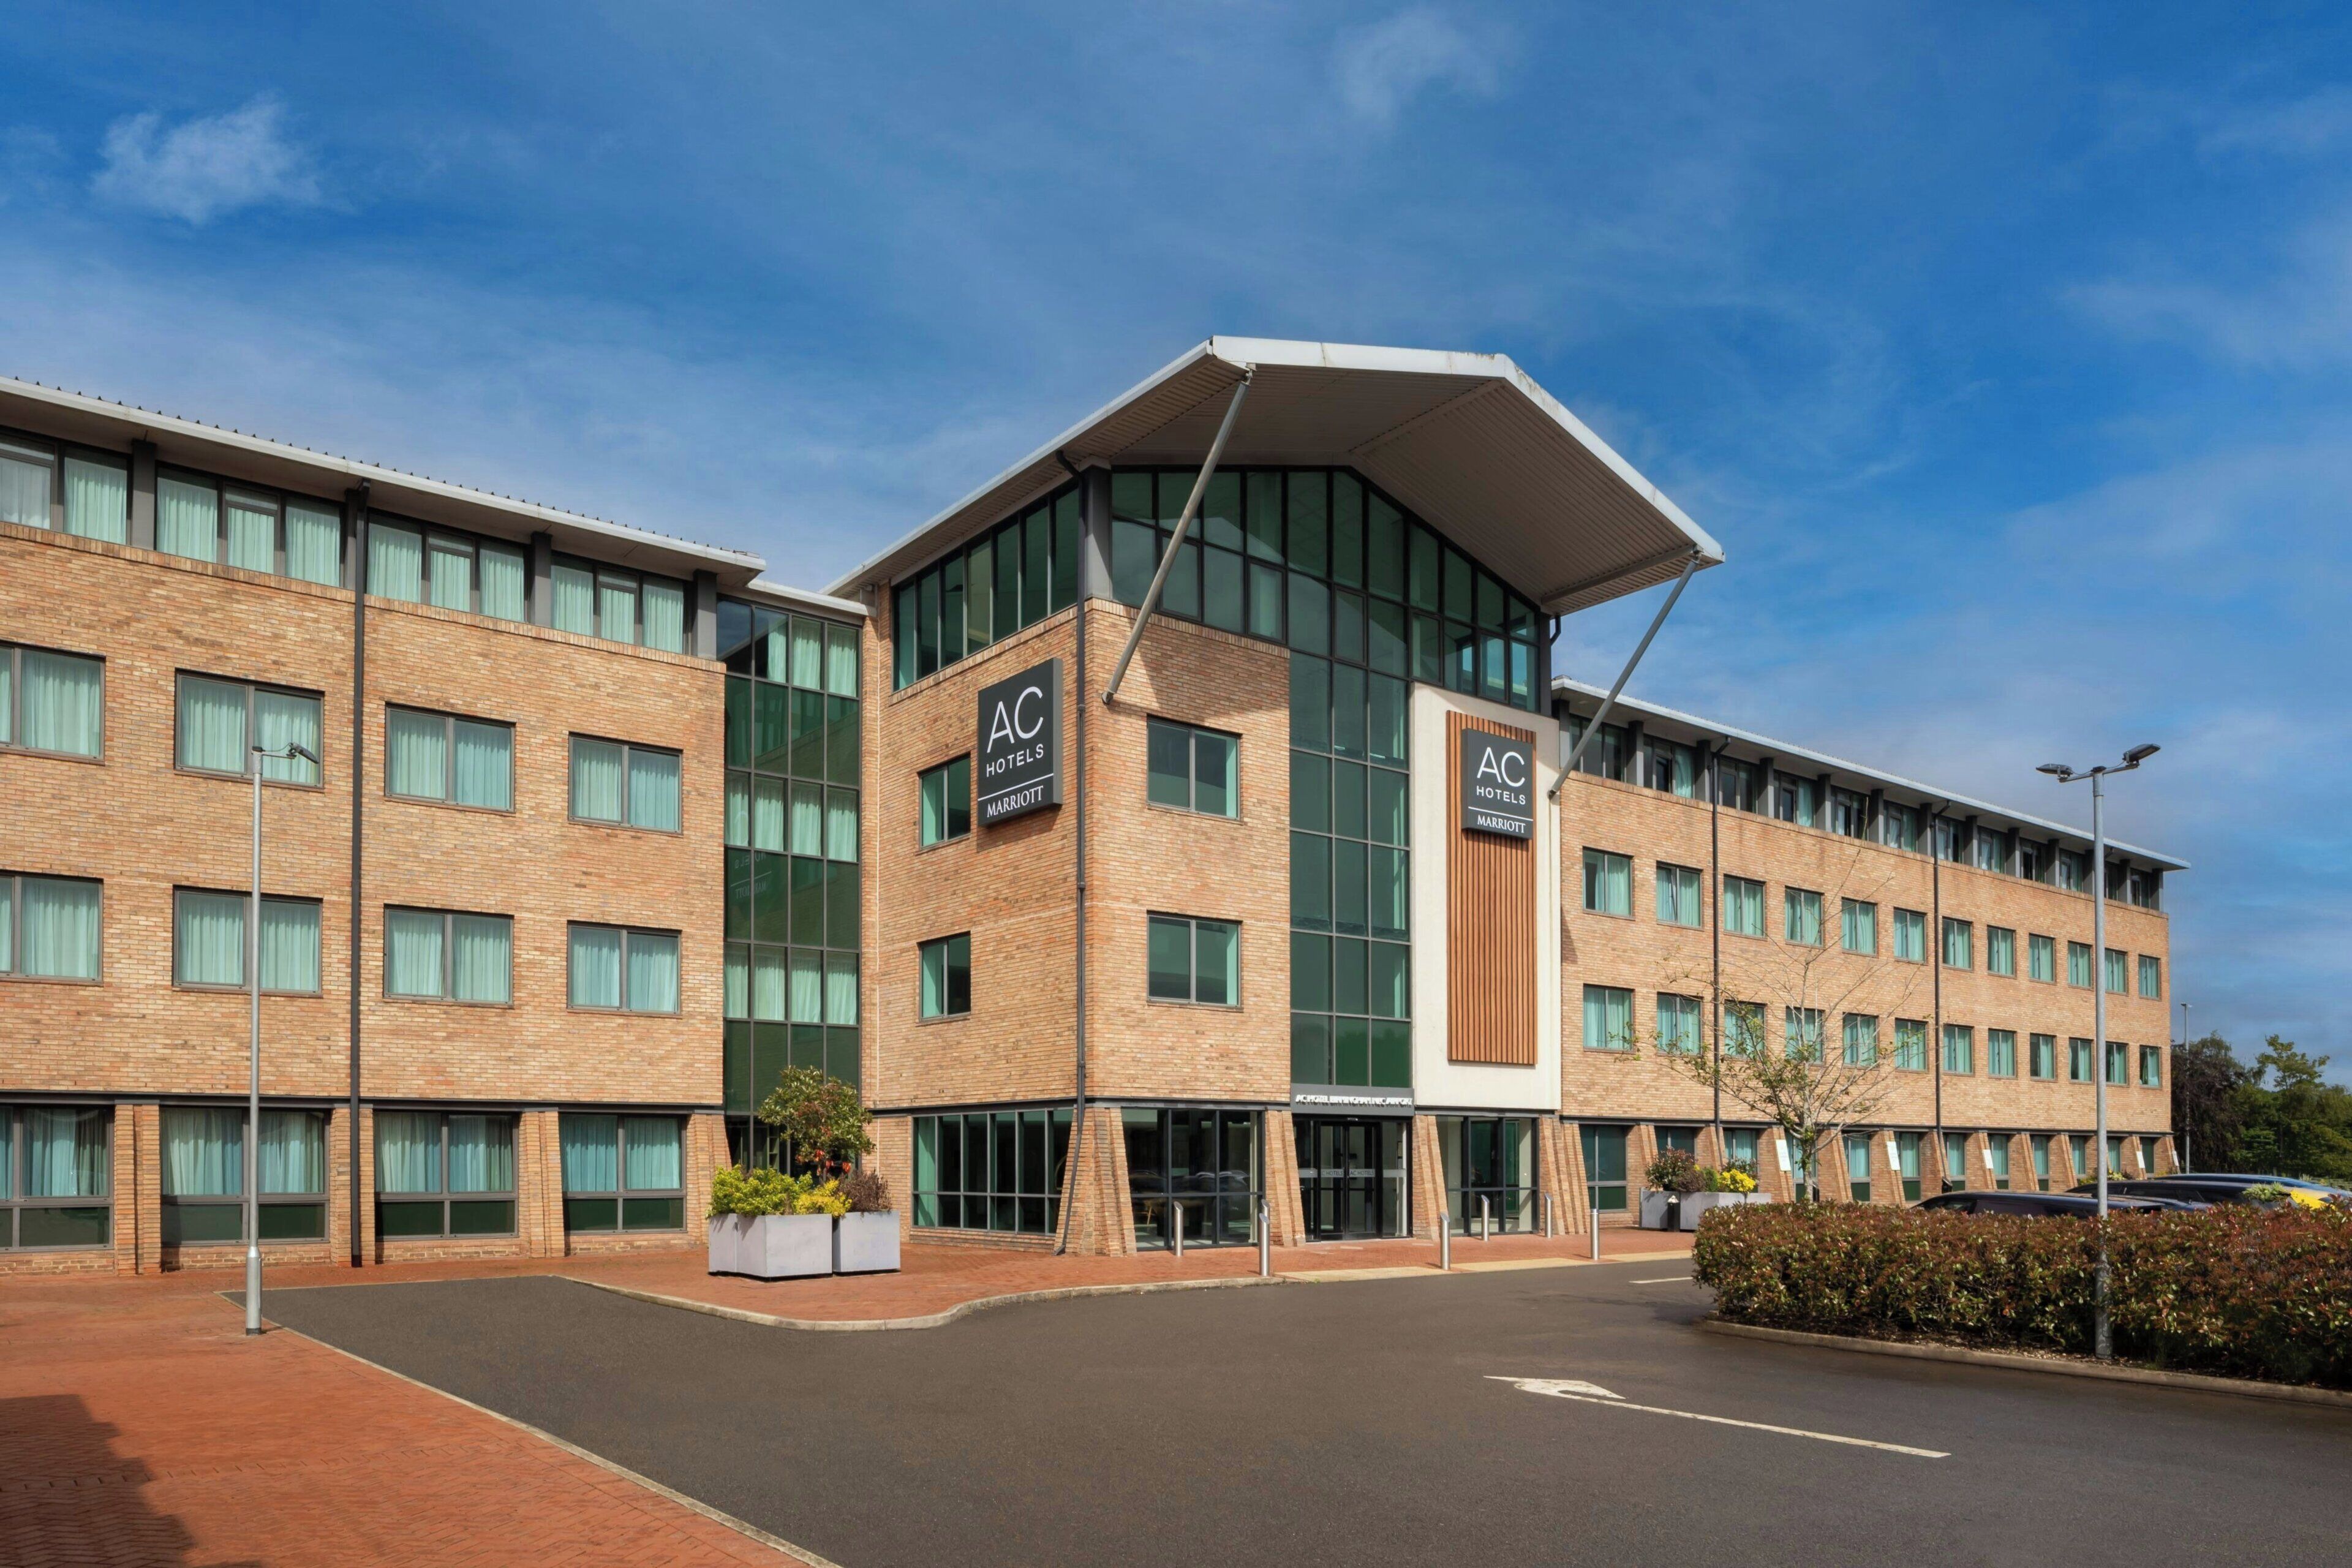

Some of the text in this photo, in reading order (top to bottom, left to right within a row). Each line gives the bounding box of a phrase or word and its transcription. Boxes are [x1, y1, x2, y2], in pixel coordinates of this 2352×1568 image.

[987, 686, 1043, 753] AC
[987, 744, 1044, 777] HOTELS
[1477, 747, 1525, 787] AC
[987, 785, 1044, 818] MARRIOTT
[1477, 785, 1526, 805] HOTELS
[1477, 815, 1526, 834] MARRIOTT
